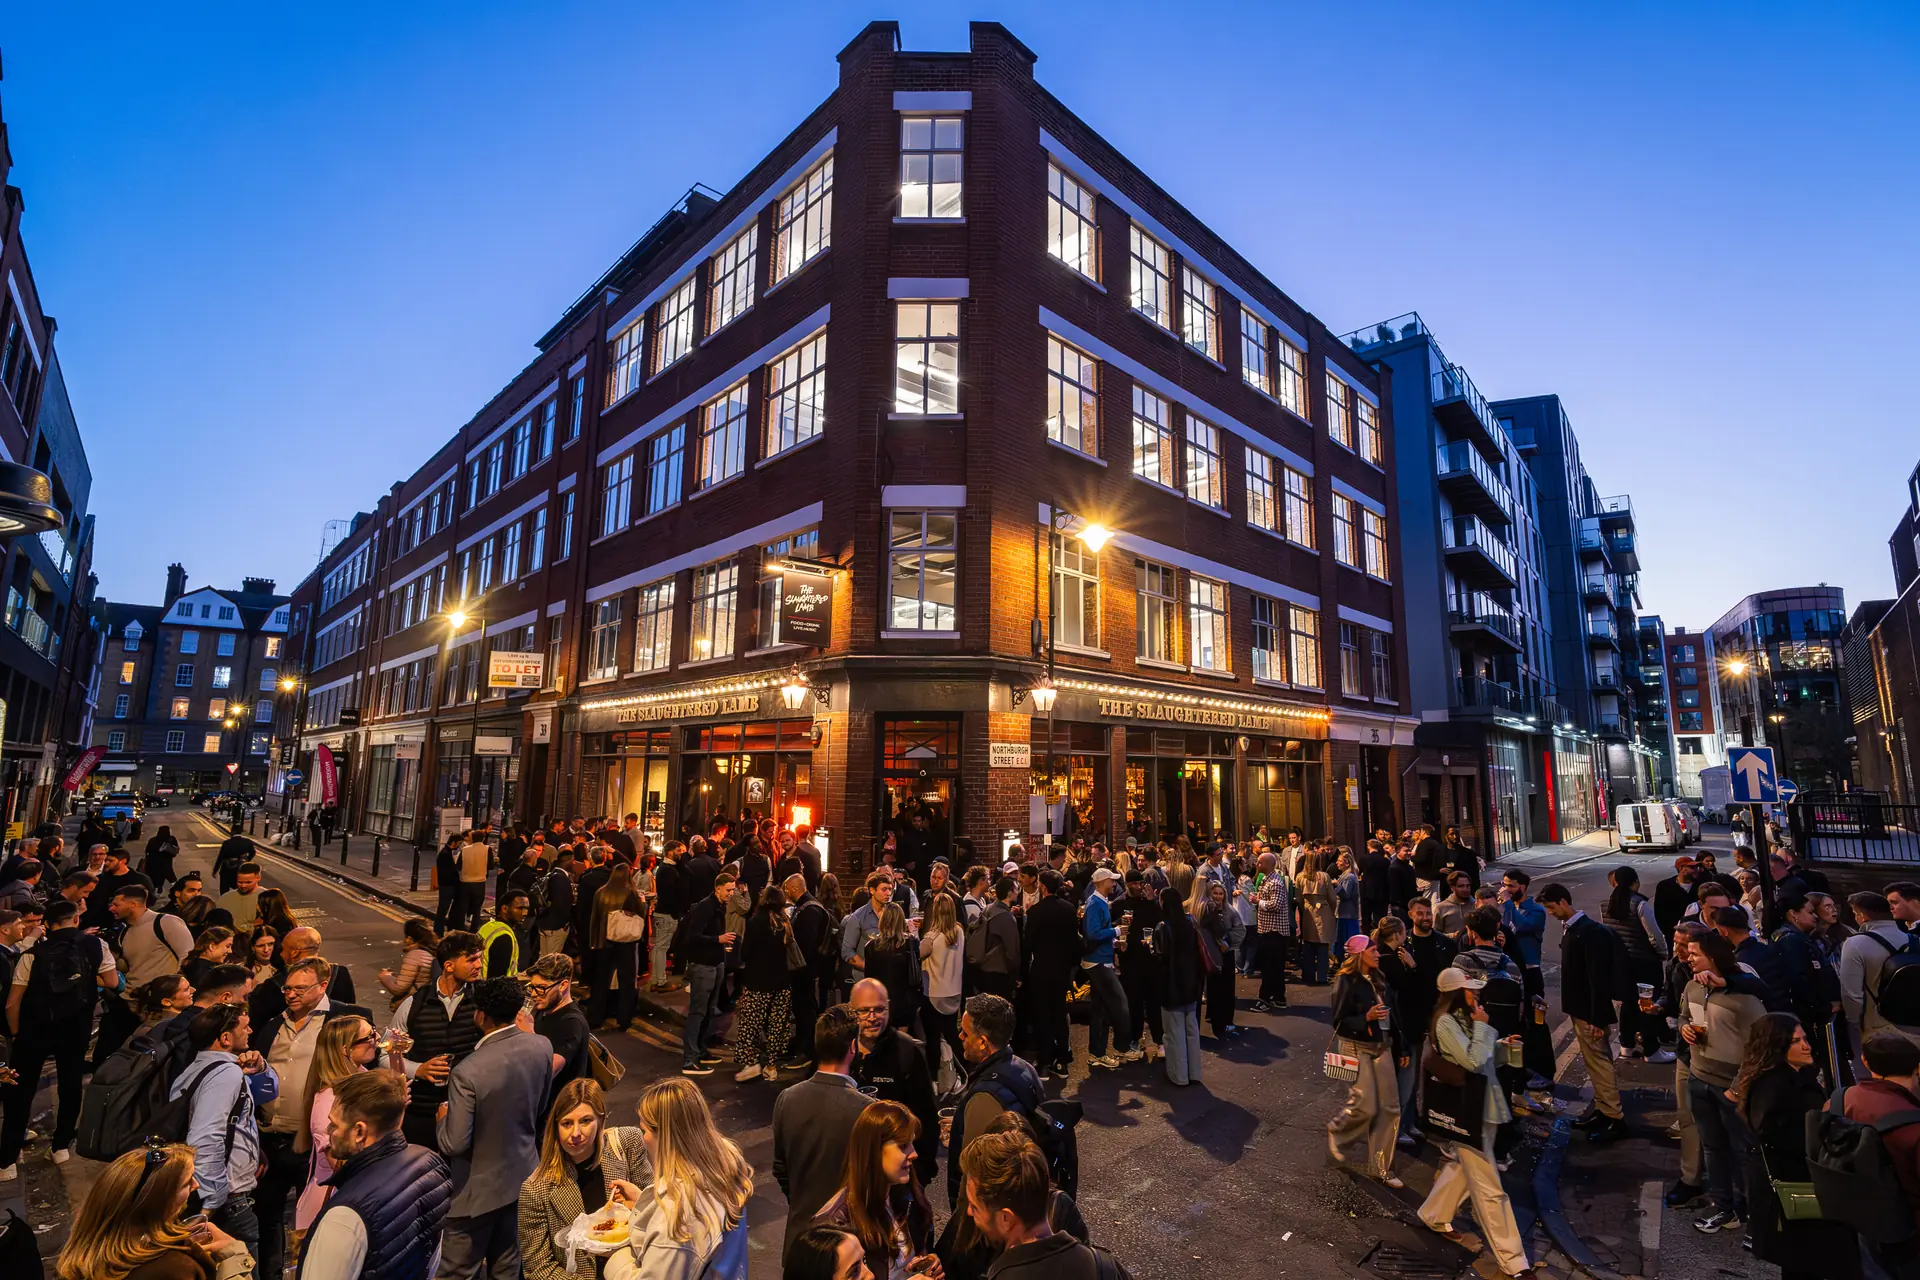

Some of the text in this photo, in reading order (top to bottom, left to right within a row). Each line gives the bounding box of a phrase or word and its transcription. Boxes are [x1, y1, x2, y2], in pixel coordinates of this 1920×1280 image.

[800, 584, 814, 595] THE
[785, 594, 829, 606] SLAUGHTERED
[794, 603, 814, 613] LAMB
[494, 664, 540, 674] TO LET
[617, 695, 760, 722] THE SLAUGHTERED LAMB
[1098, 698, 1271, 730] THE SLAUGHTERED LAMB
[540, 724, 548, 736] 33
[992, 746, 1029, 755] NORTHBURGH
[994, 756, 1014, 765] STREET
